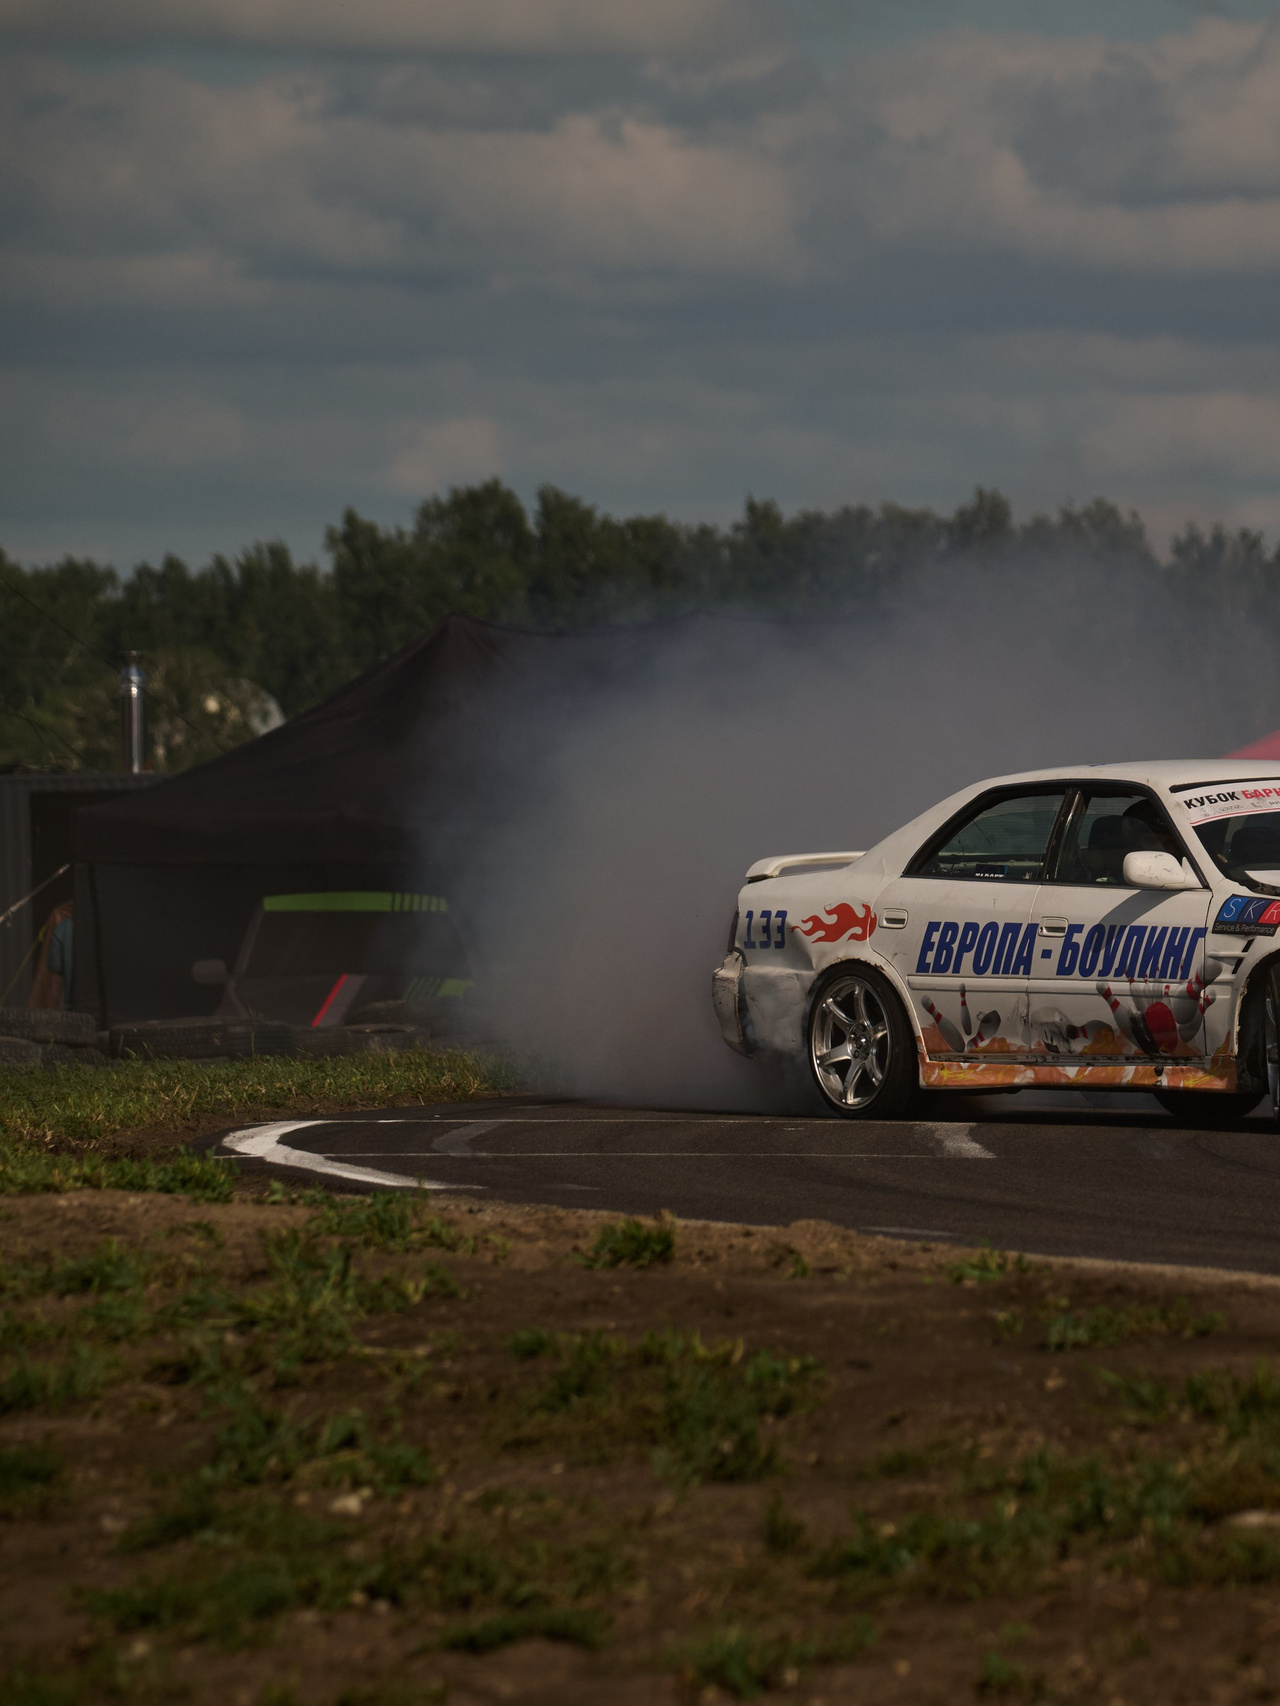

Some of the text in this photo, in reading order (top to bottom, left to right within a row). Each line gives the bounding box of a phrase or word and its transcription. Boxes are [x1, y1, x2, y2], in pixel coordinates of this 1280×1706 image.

[1183, 791, 1241, 809] КУБОК
[743, 910, 788, 949] 133
[1214, 922, 1235, 932] Service
[915, 921, 1036, 976] ЕВРОПА
[1056, 923, 1208, 981] БОУЛИНГ
